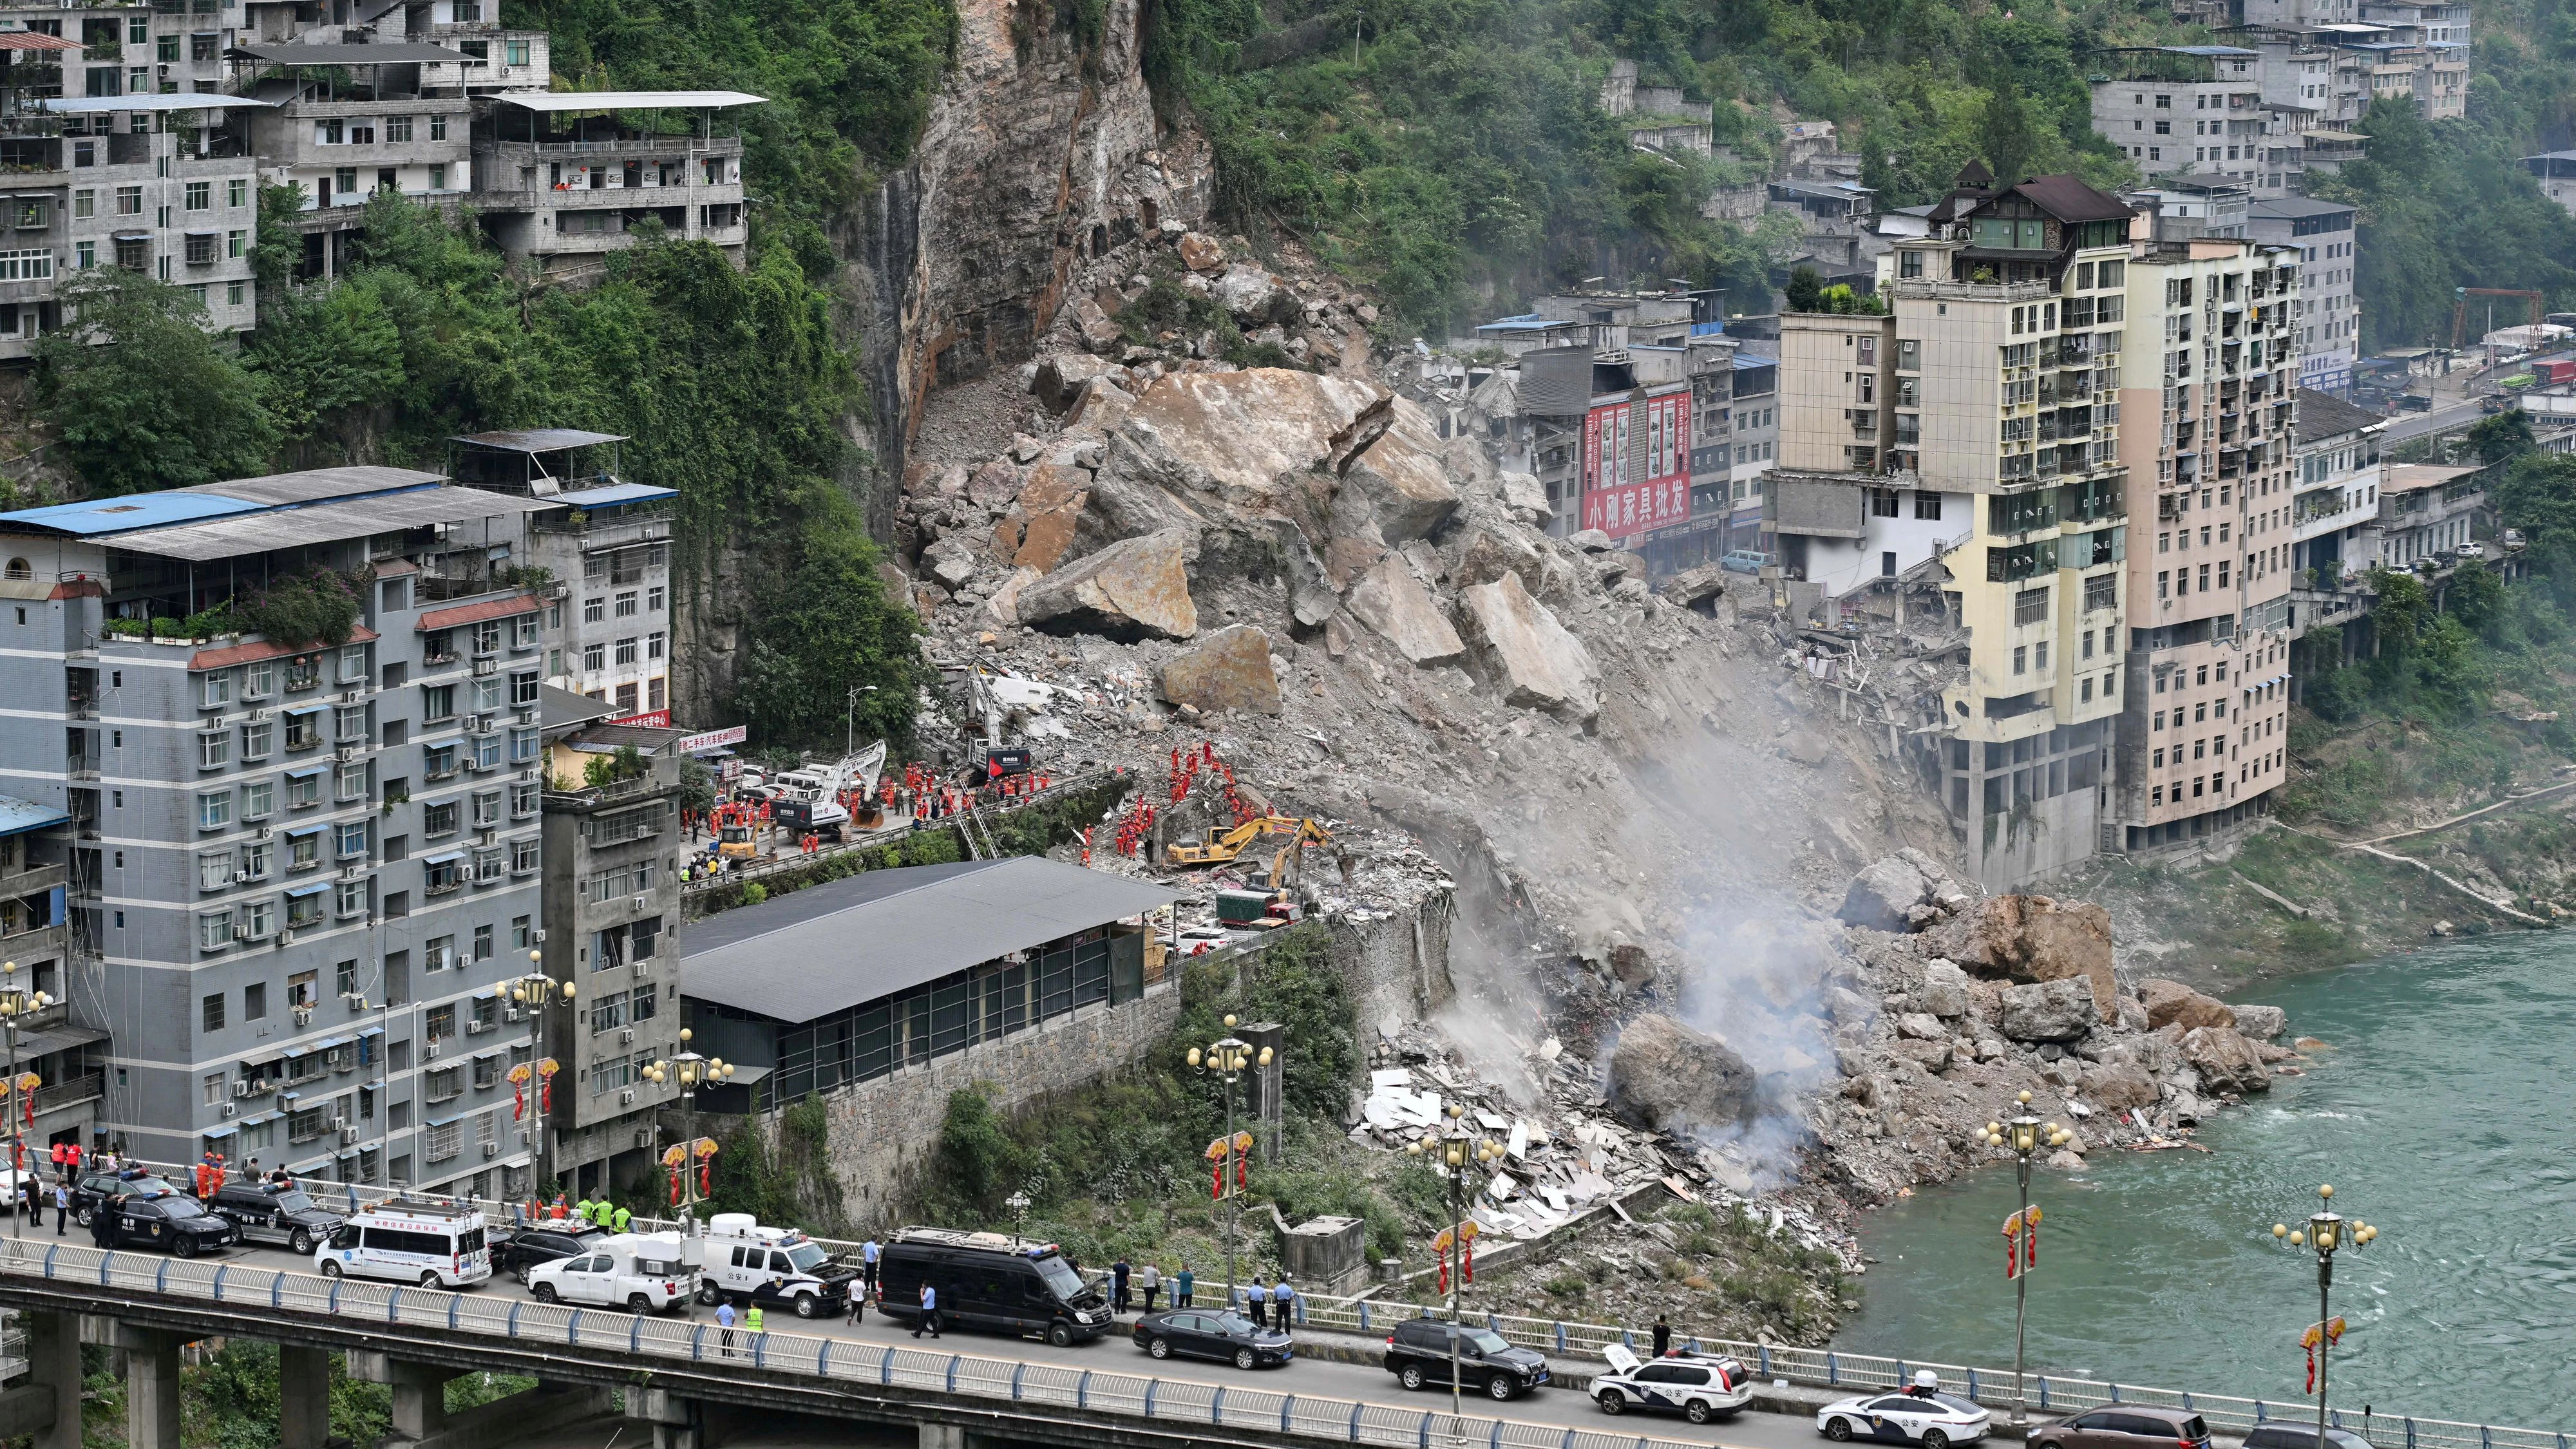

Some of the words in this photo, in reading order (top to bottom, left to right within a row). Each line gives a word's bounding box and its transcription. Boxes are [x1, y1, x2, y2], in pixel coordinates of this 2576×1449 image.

[1589, 479, 1684, 530] 小刚家具批发
[620, 713, 666, 726] 批发运营中心
[122, 1218, 135, 1227] 特警
[375, 1220, 437, 1232] 地理信息应急保障
[728, 1272, 742, 1281] 公安
[677, 1280, 701, 1290] CHAAN
[1665, 1388, 1682, 1397] 公安
[1902, 1419, 1919, 1428] 公安
